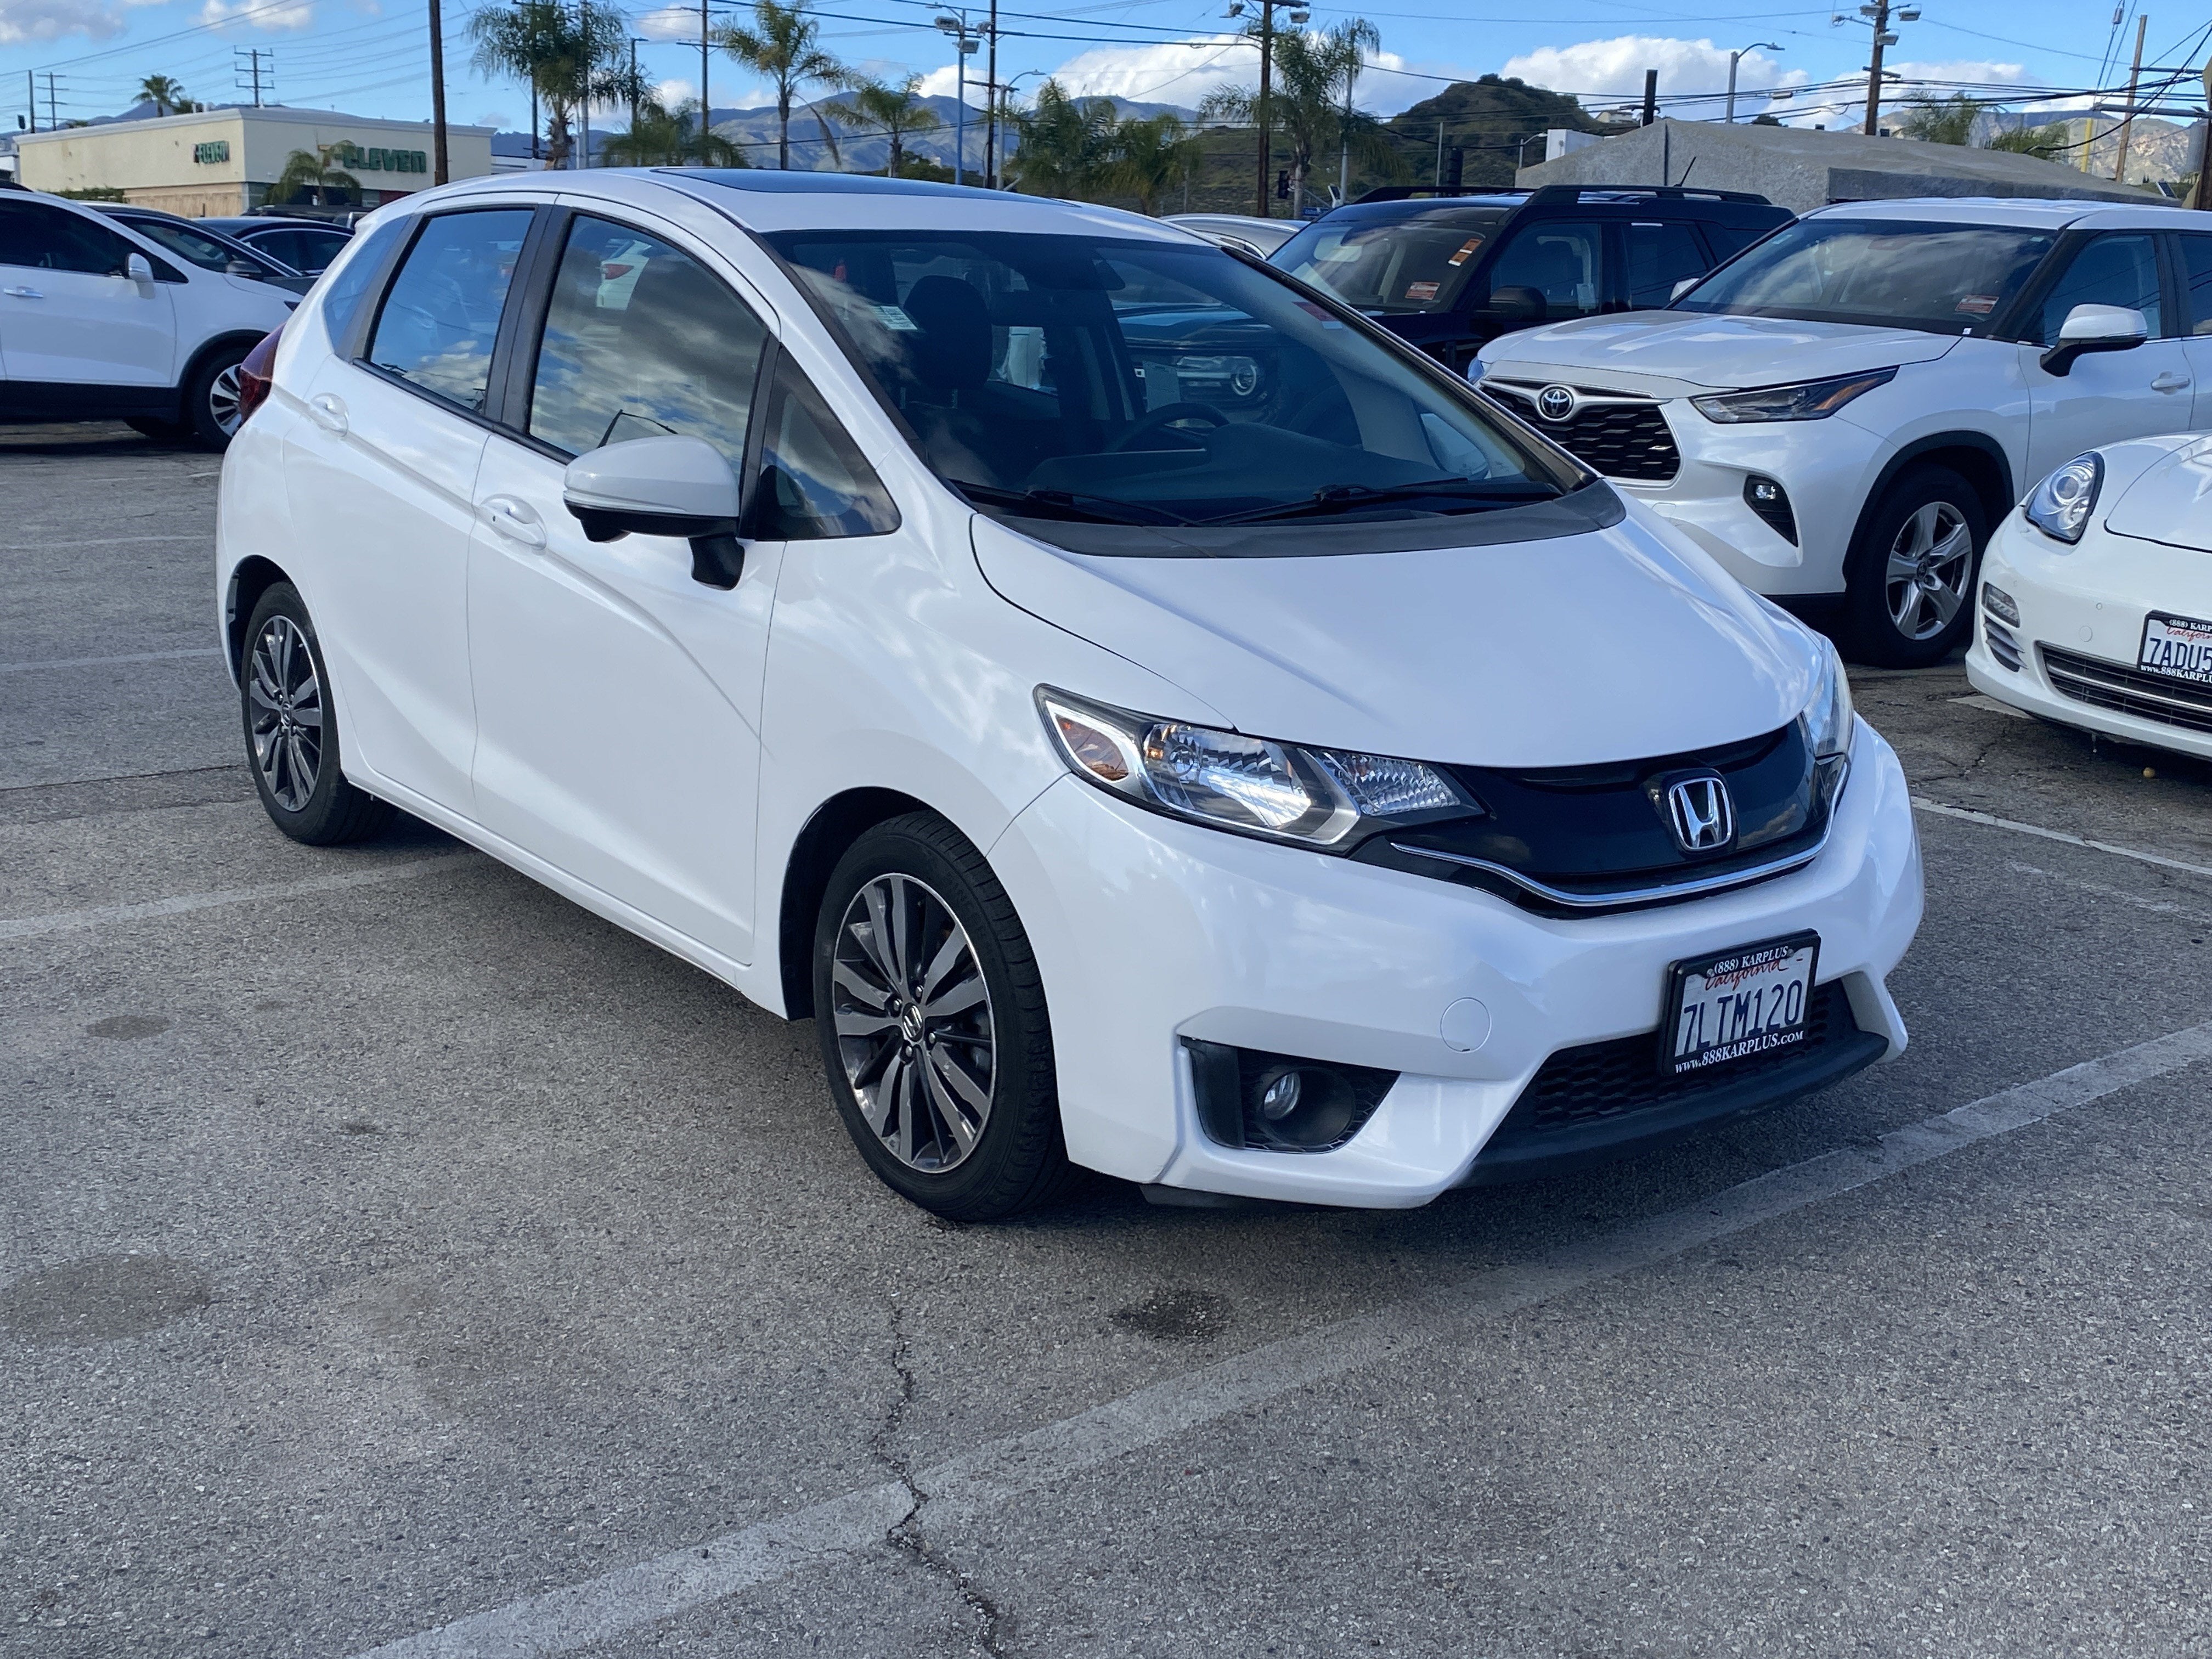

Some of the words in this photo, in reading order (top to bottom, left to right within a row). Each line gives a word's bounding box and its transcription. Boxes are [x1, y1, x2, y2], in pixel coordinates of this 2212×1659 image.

[2169, 619, 2188, 628] (888)
[2149, 637, 2212, 673] 7ADU5
[1714, 958, 1739, 974] (888)
[1741, 945, 1789, 968] KARPLUS
[1684, 979, 1803, 1054] 7LTM120
